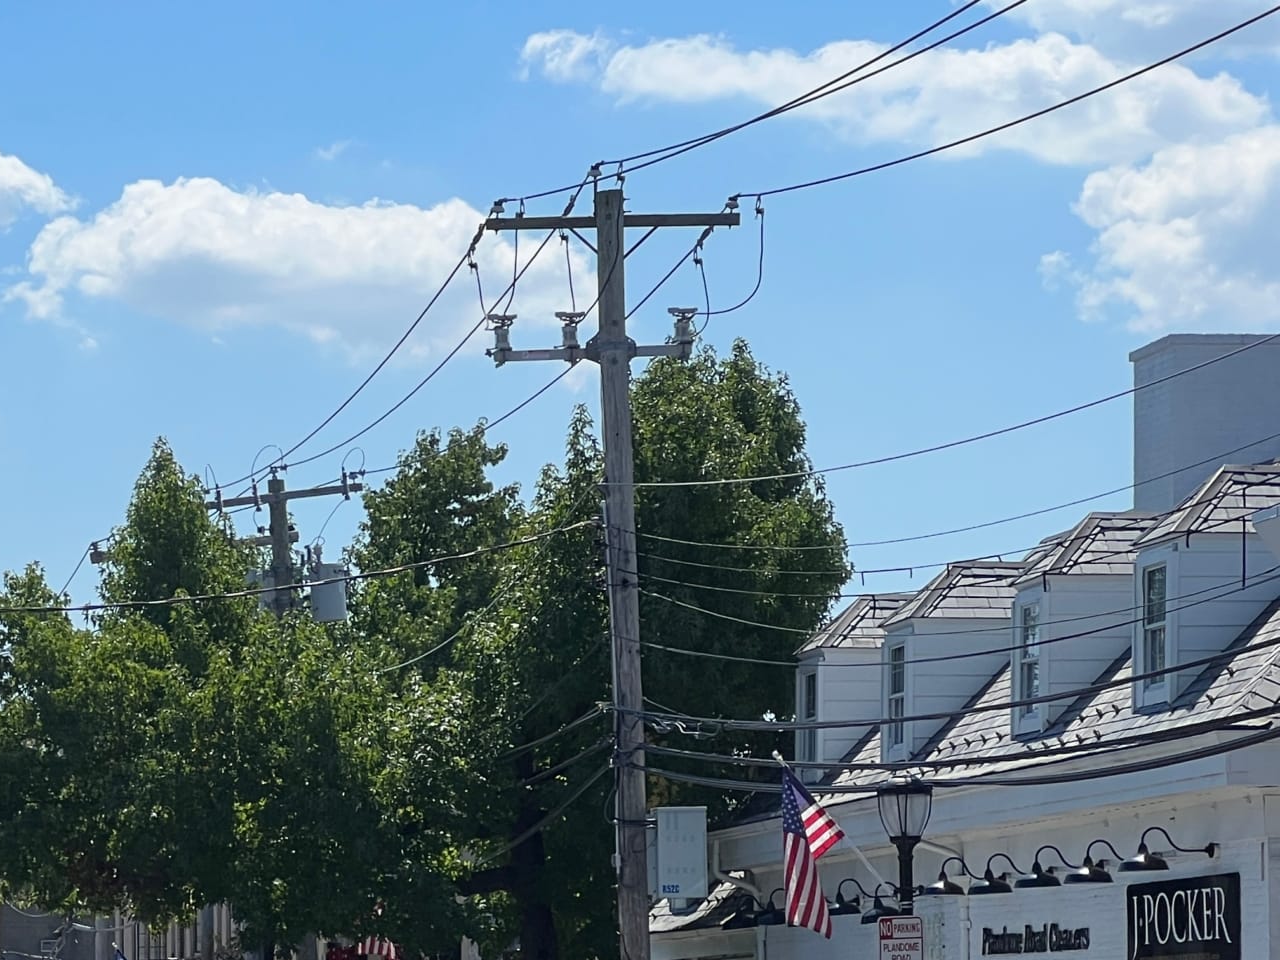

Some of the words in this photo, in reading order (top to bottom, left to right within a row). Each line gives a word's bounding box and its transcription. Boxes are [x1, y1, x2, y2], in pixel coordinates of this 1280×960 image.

[880, 921, 893, 938] NO
[893, 923, 920, 934] PARKING
[883, 943, 920, 952] PLANDOME
